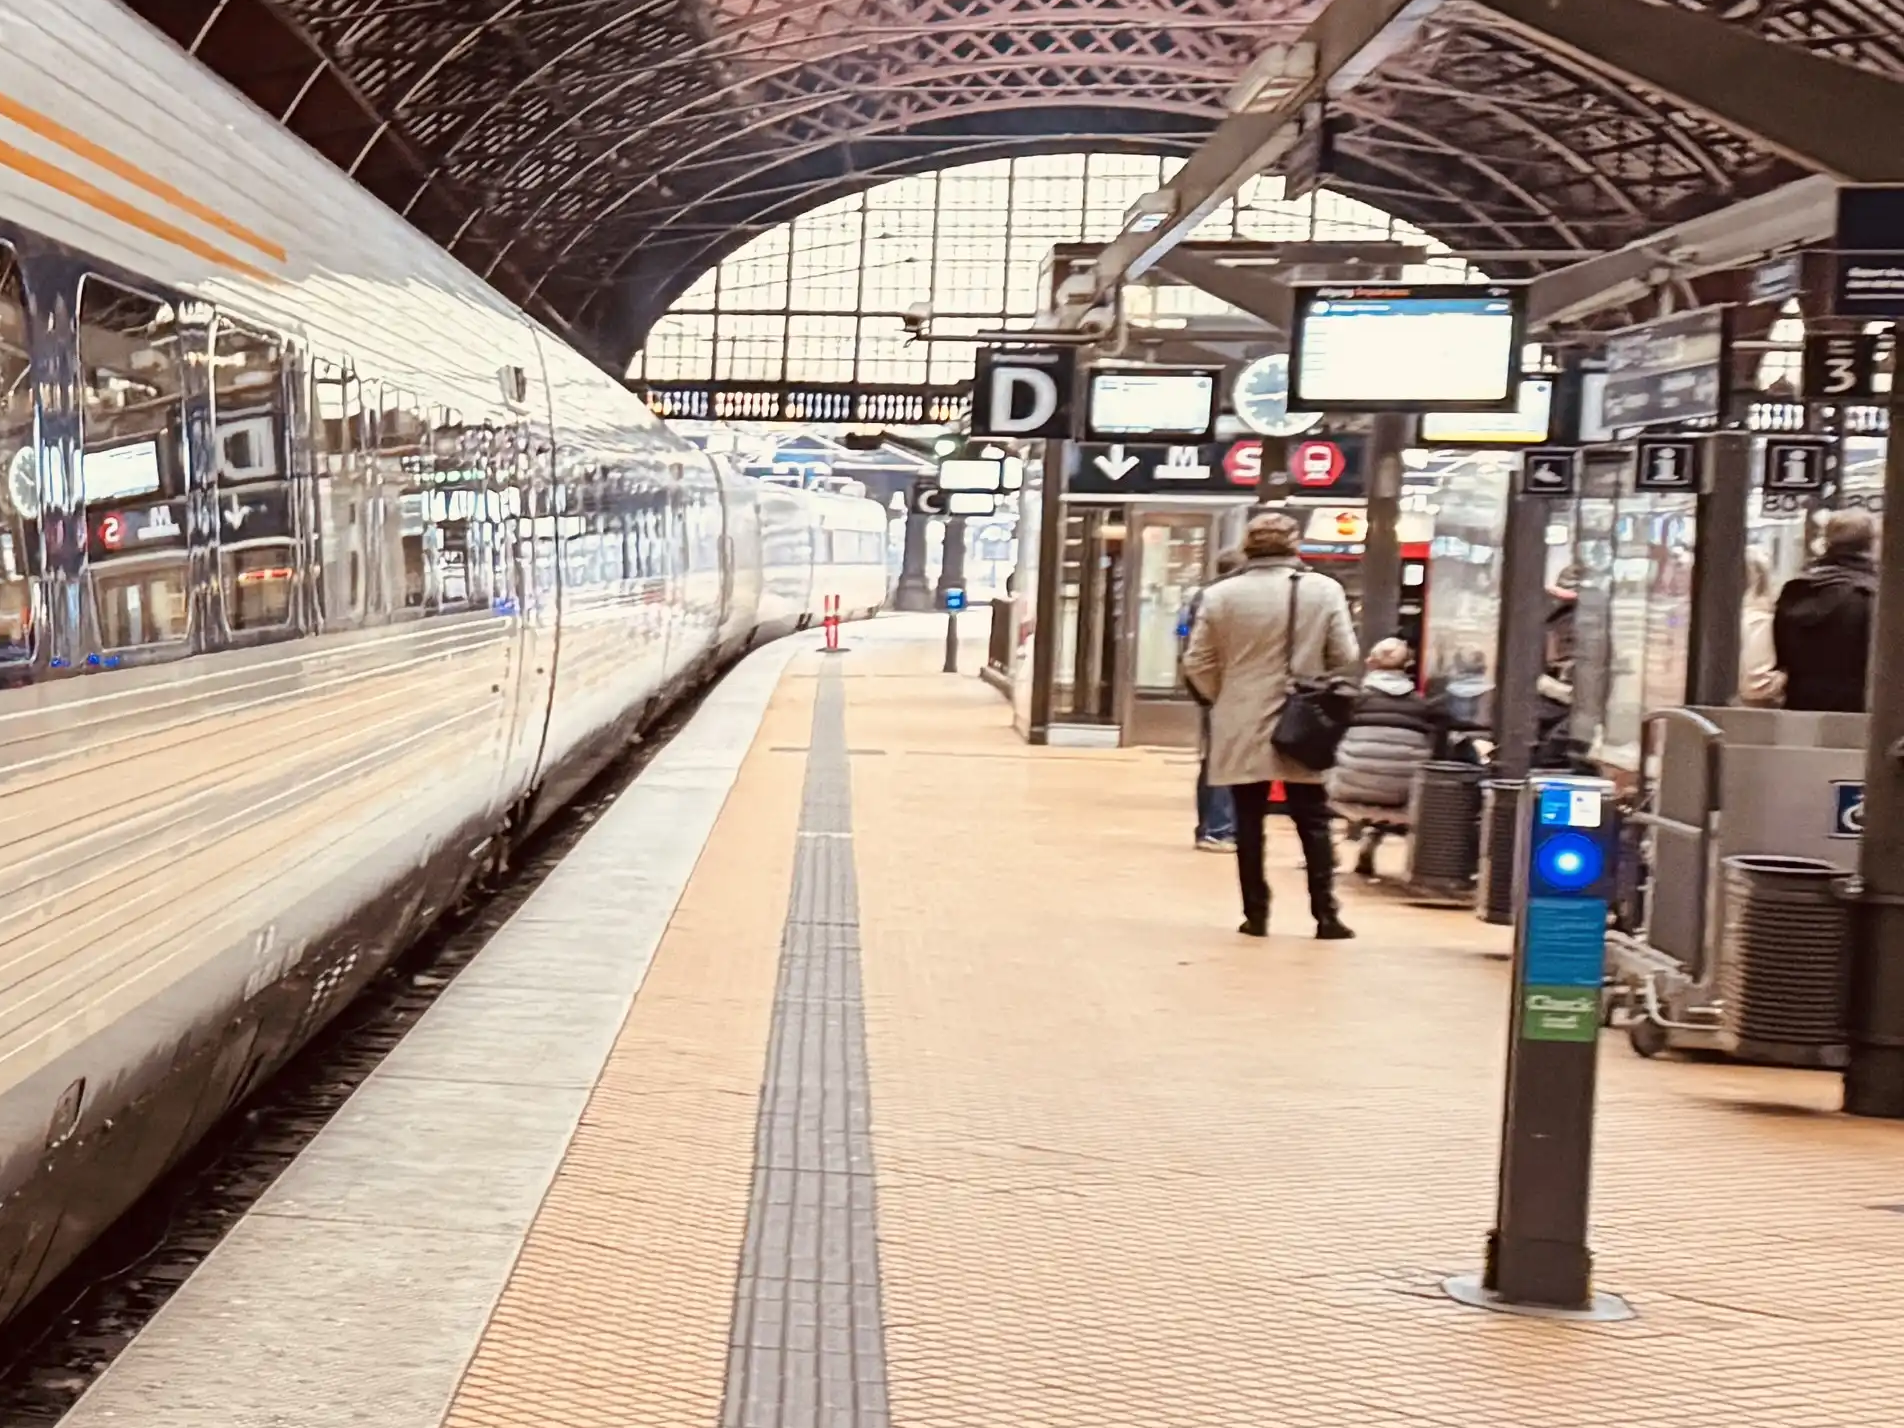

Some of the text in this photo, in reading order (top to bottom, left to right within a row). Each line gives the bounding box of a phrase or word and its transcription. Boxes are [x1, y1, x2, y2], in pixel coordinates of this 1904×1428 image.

[1824, 358, 1856, 393] 3
[990, 367, 1058, 433] D
[918, 489, 942, 514] C
